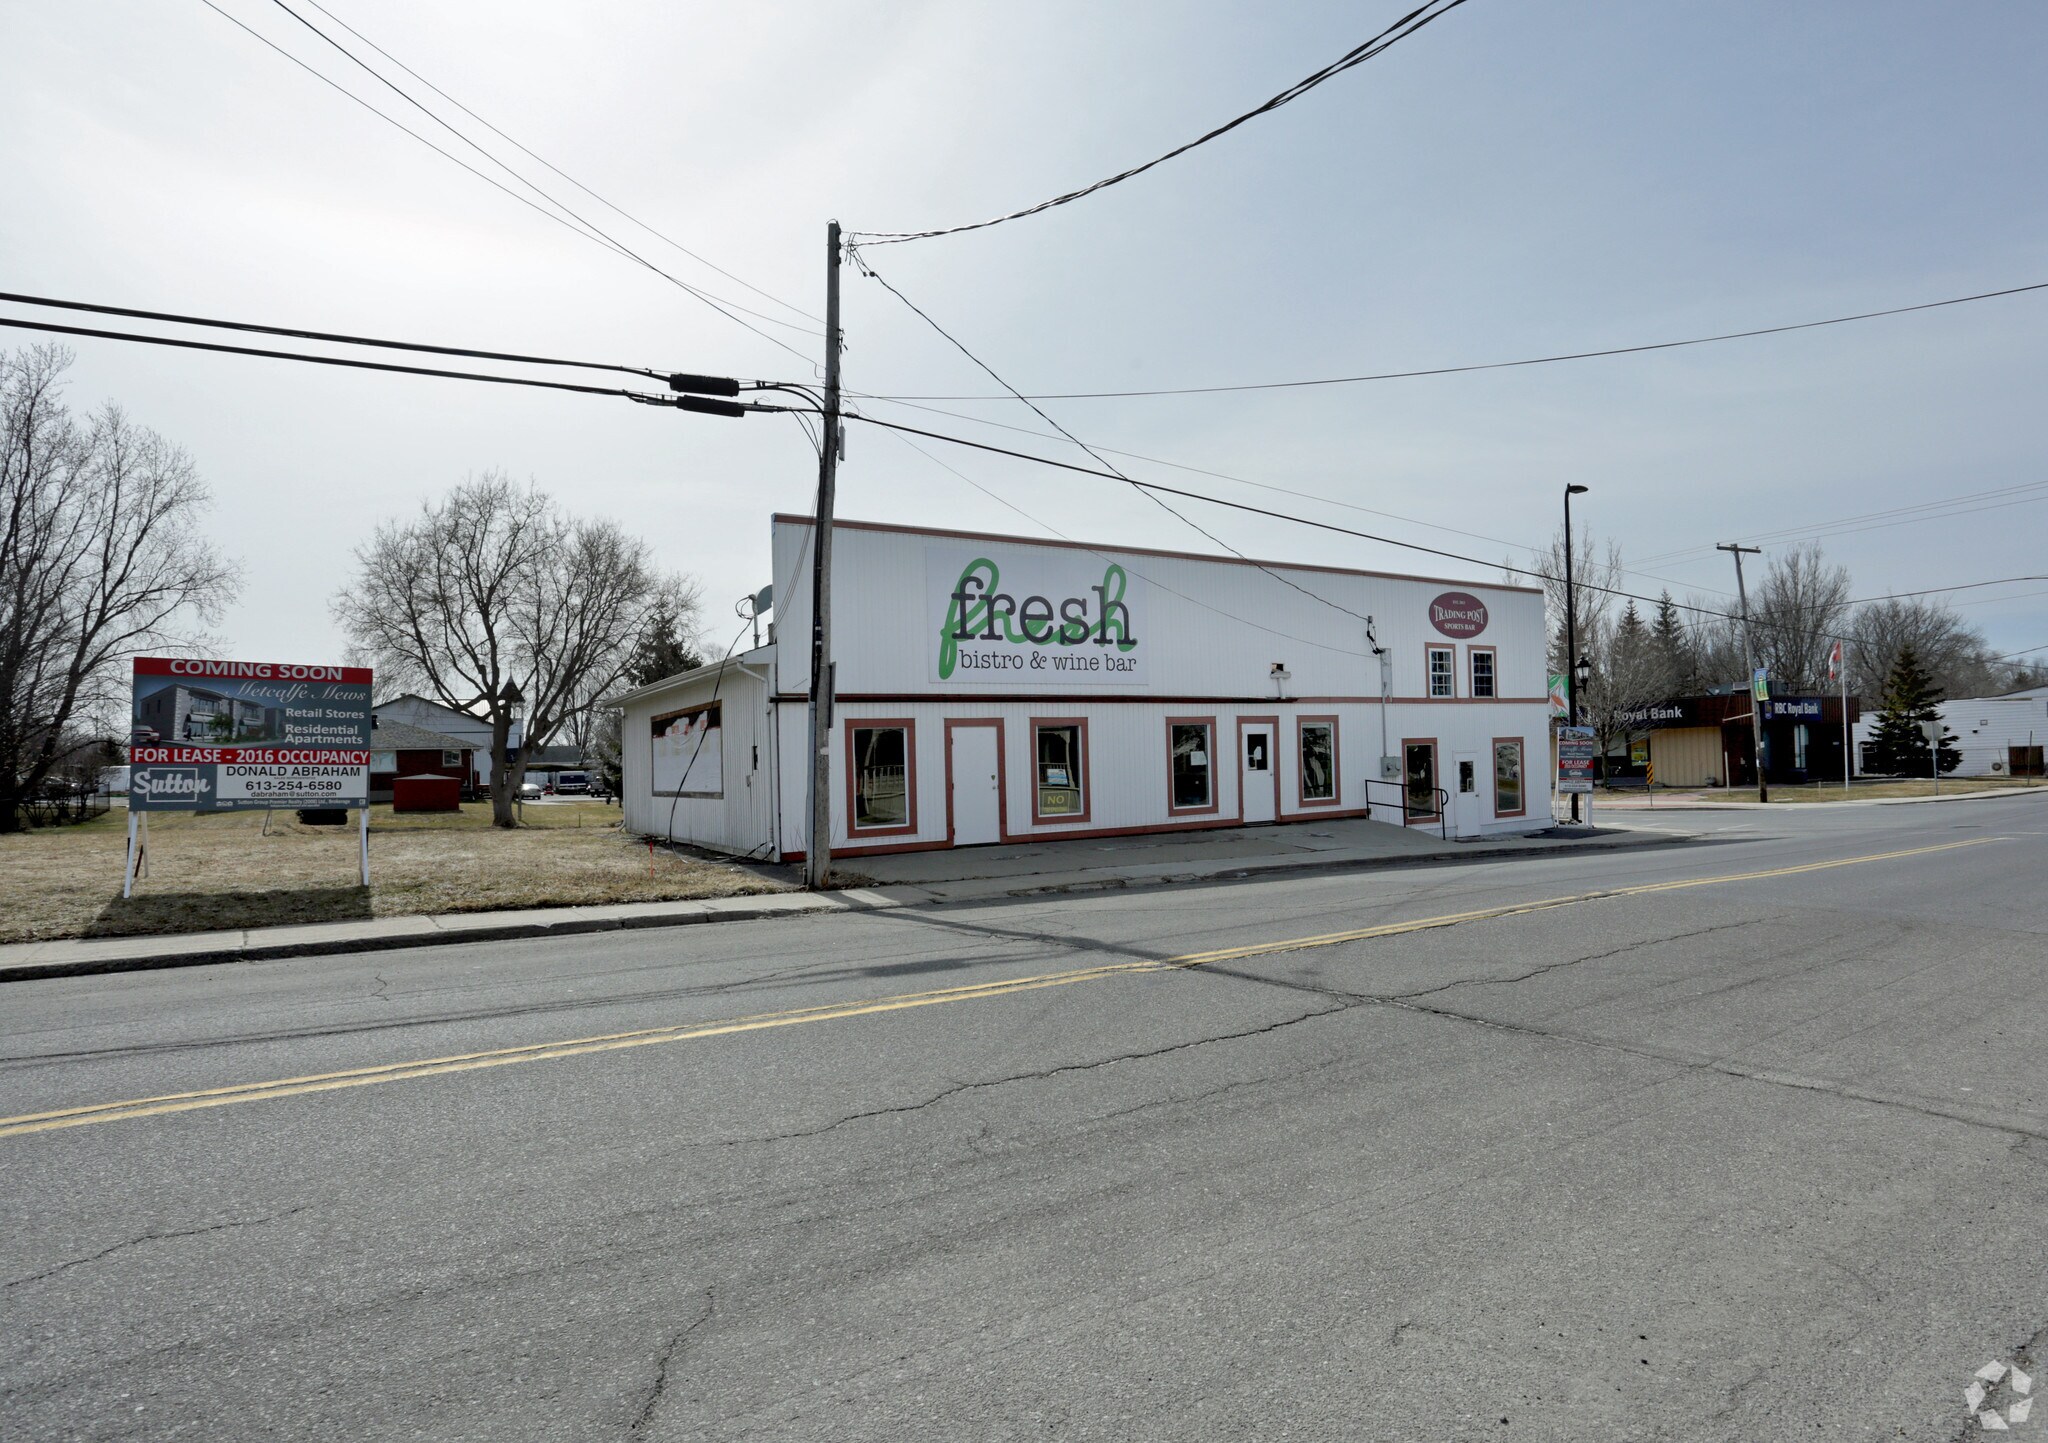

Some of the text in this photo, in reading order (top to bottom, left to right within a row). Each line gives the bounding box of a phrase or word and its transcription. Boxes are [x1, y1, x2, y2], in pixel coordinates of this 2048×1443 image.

[951, 575, 1137, 645] fresh
[1433, 604, 1484, 624] TRADING POST
[1464, 623, 1476, 631] BAR
[958, 649, 1137, 672] bistro & wine bar
[169, 659, 343, 681] COMING SOON
[285, 707, 365, 719] Retail Stores
[1650, 705, 1683, 719] Bank
[1774, 702, 1818, 716] RBC Royal Bank
[285, 724, 358, 735] Residential
[284, 734, 363, 745] Apartments
[134, 748, 169, 762] FOR
[173, 749, 221, 763] LEASE
[236, 750, 274, 764] 2016
[277, 750, 369, 764] OCCUPANCY
[226, 765, 361, 777] DONALD ABRAHAM
[133, 770, 211, 794] Sutton
[245, 780, 342, 791] 613-254-6580
[250, 790, 337, 798] dabraham@sutton.com
[1047, 795, 1065, 804] NO
